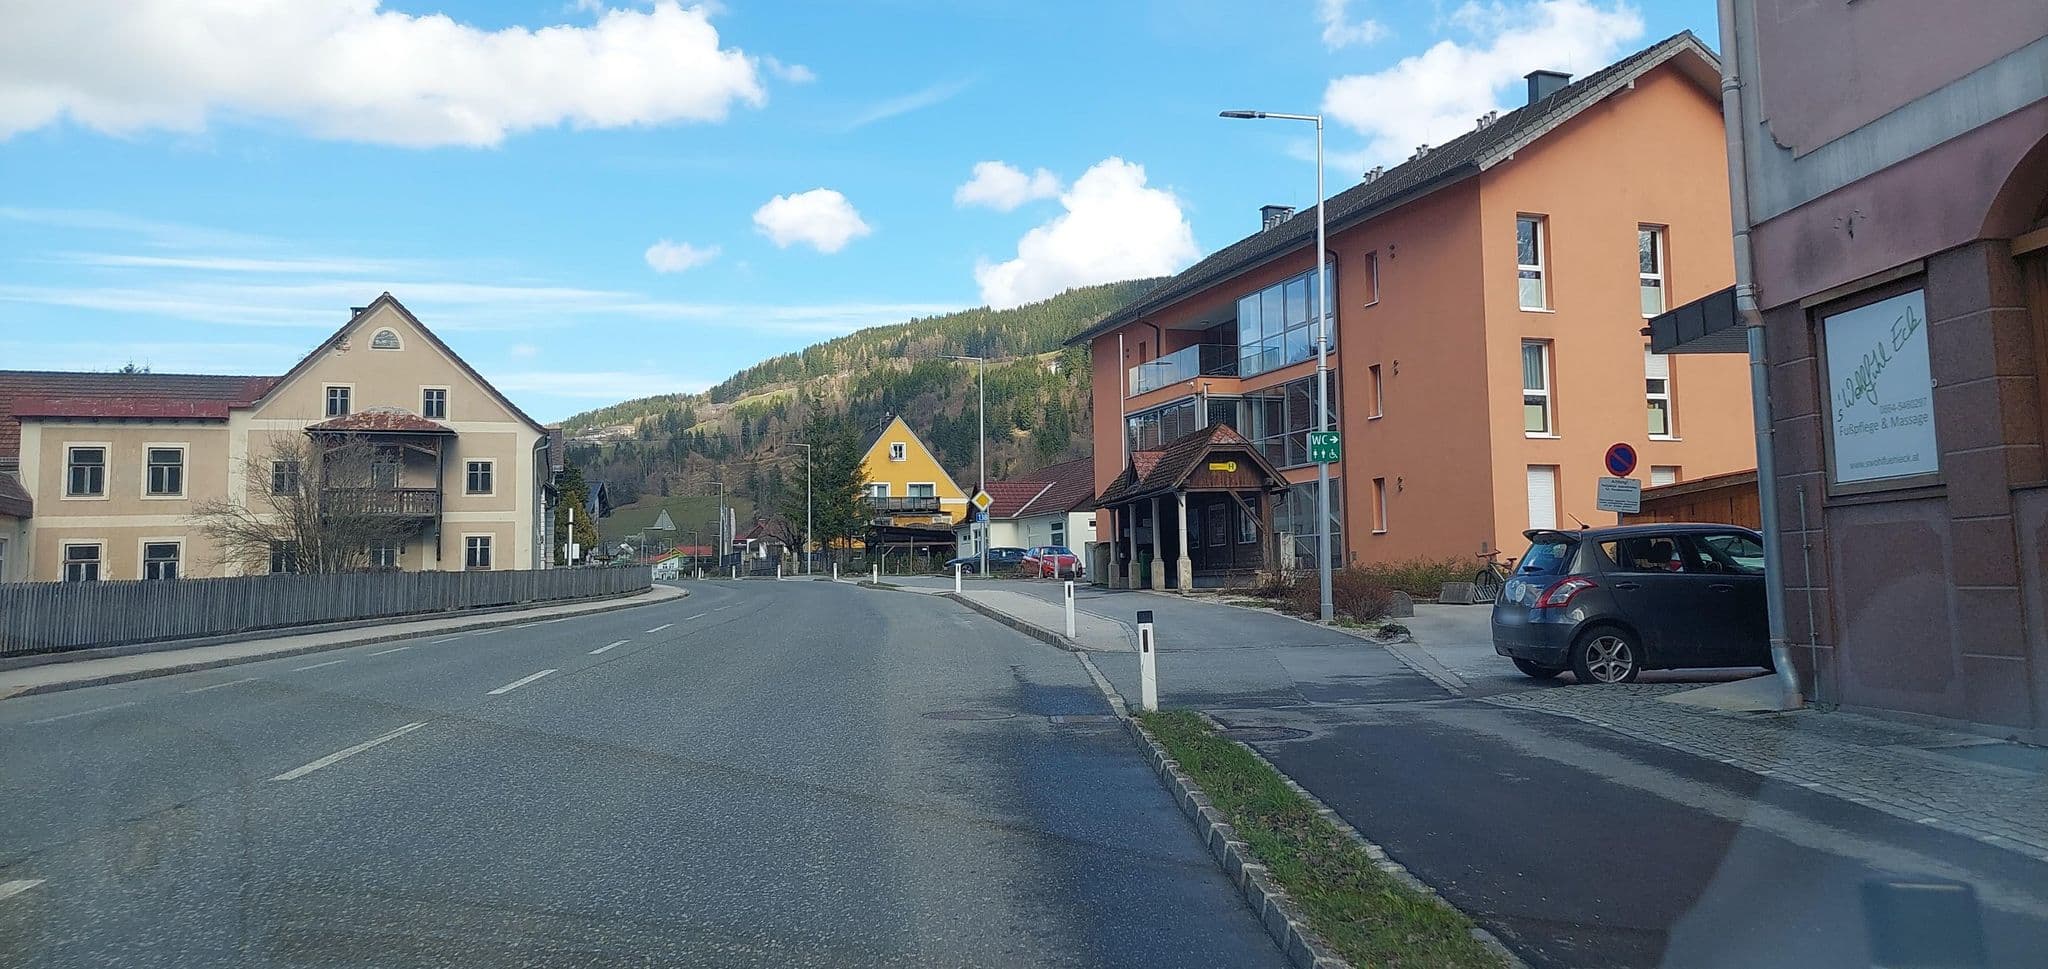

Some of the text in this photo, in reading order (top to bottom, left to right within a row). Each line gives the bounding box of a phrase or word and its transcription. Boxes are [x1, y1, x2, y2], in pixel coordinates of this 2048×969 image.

[1839, 413, 1929, 437] Fußpflege & Massage
[1312, 434, 1328, 445] WC
[1228, 462, 1235, 470] H
